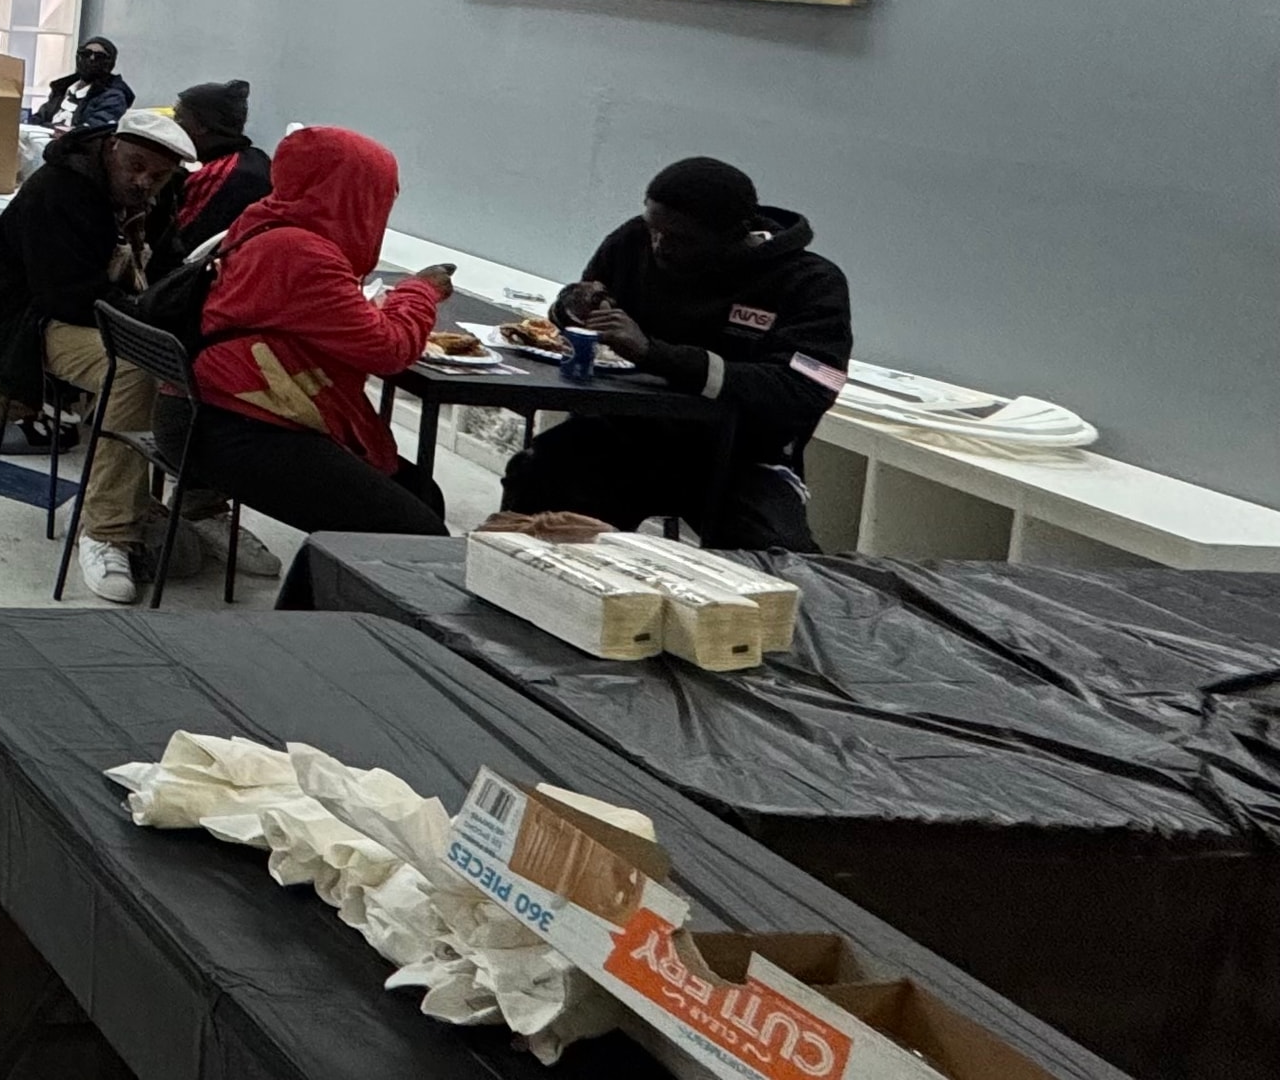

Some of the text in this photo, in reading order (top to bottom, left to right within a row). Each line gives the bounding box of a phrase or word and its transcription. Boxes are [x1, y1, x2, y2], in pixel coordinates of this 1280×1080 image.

[447, 842, 513, 902] PIECES
[515, 893, 554, 932] 360
[689, 1006, 739, 1044] CLEAR
